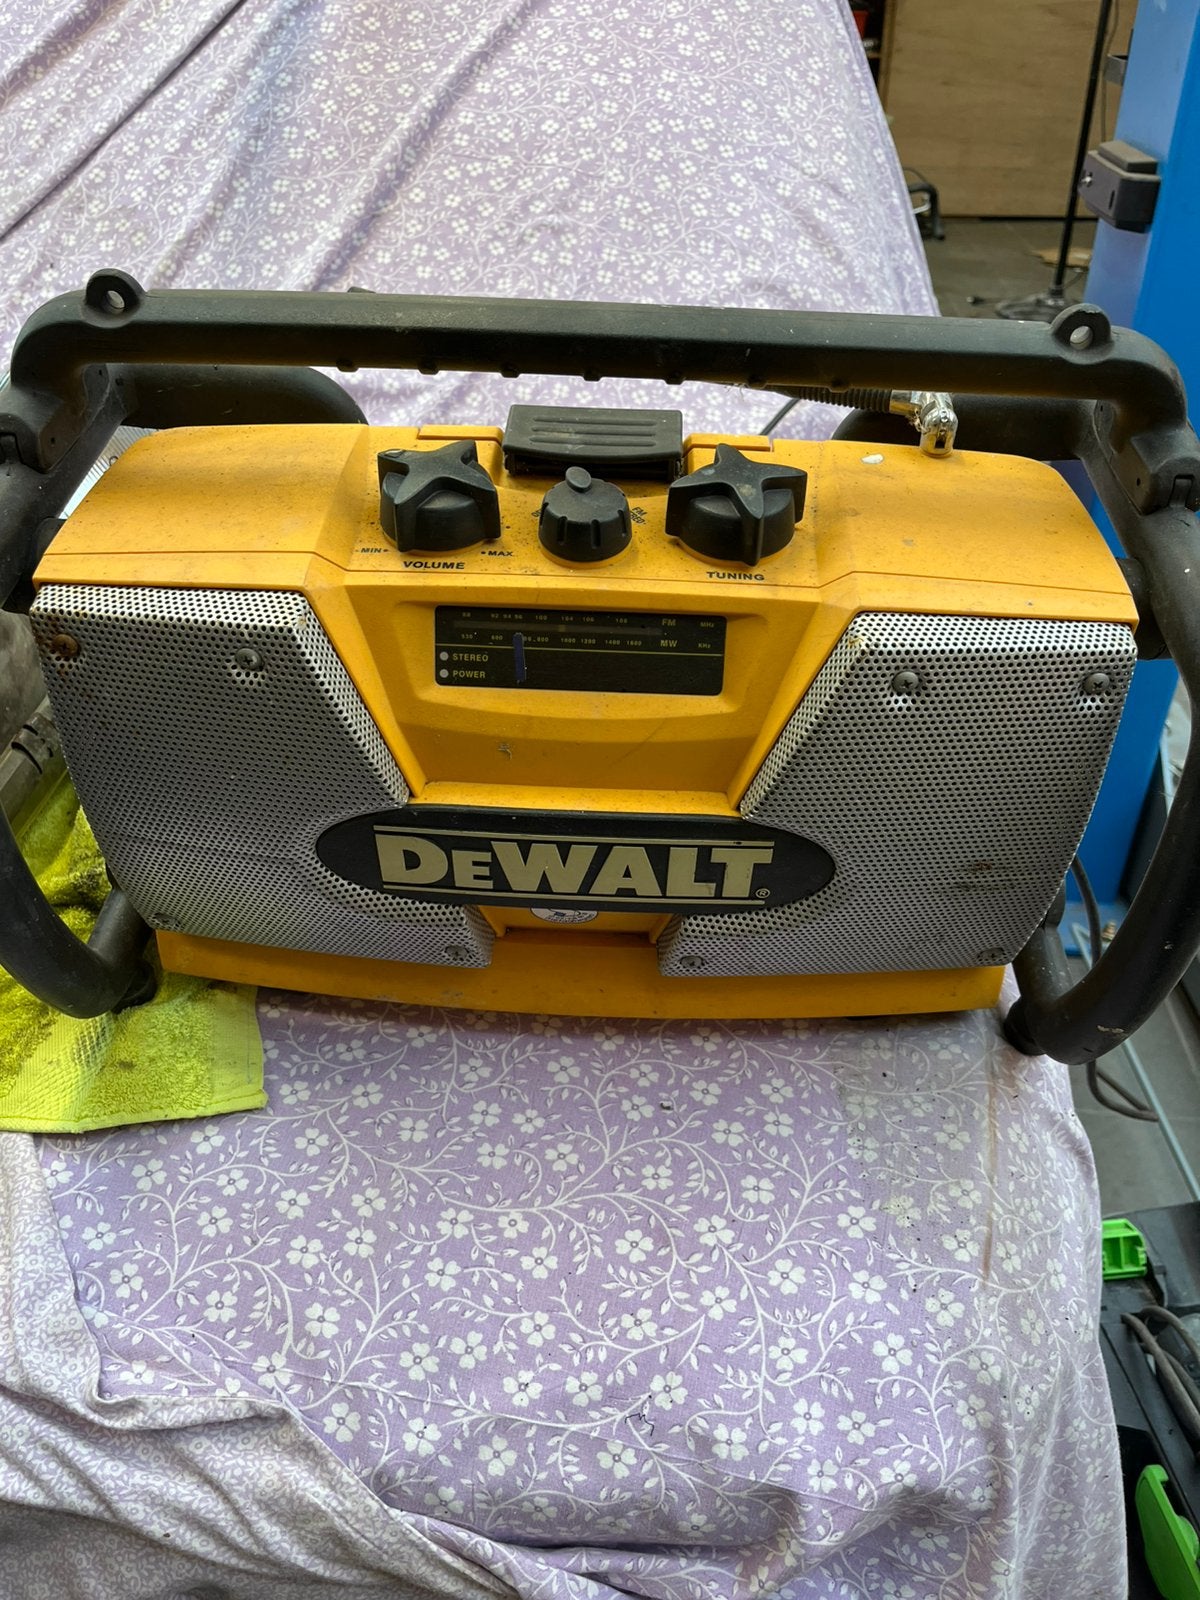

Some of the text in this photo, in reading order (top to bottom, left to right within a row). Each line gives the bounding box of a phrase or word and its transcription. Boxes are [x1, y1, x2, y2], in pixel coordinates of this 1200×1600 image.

[403, 560, 466, 570] VOLUME
[706, 571, 765, 581] TUNING
[661, 618, 677, 627] FM
[660, 639, 678, 648] MW
[452, 653, 489, 662] STEREO
[452, 669, 486, 679] POWER
